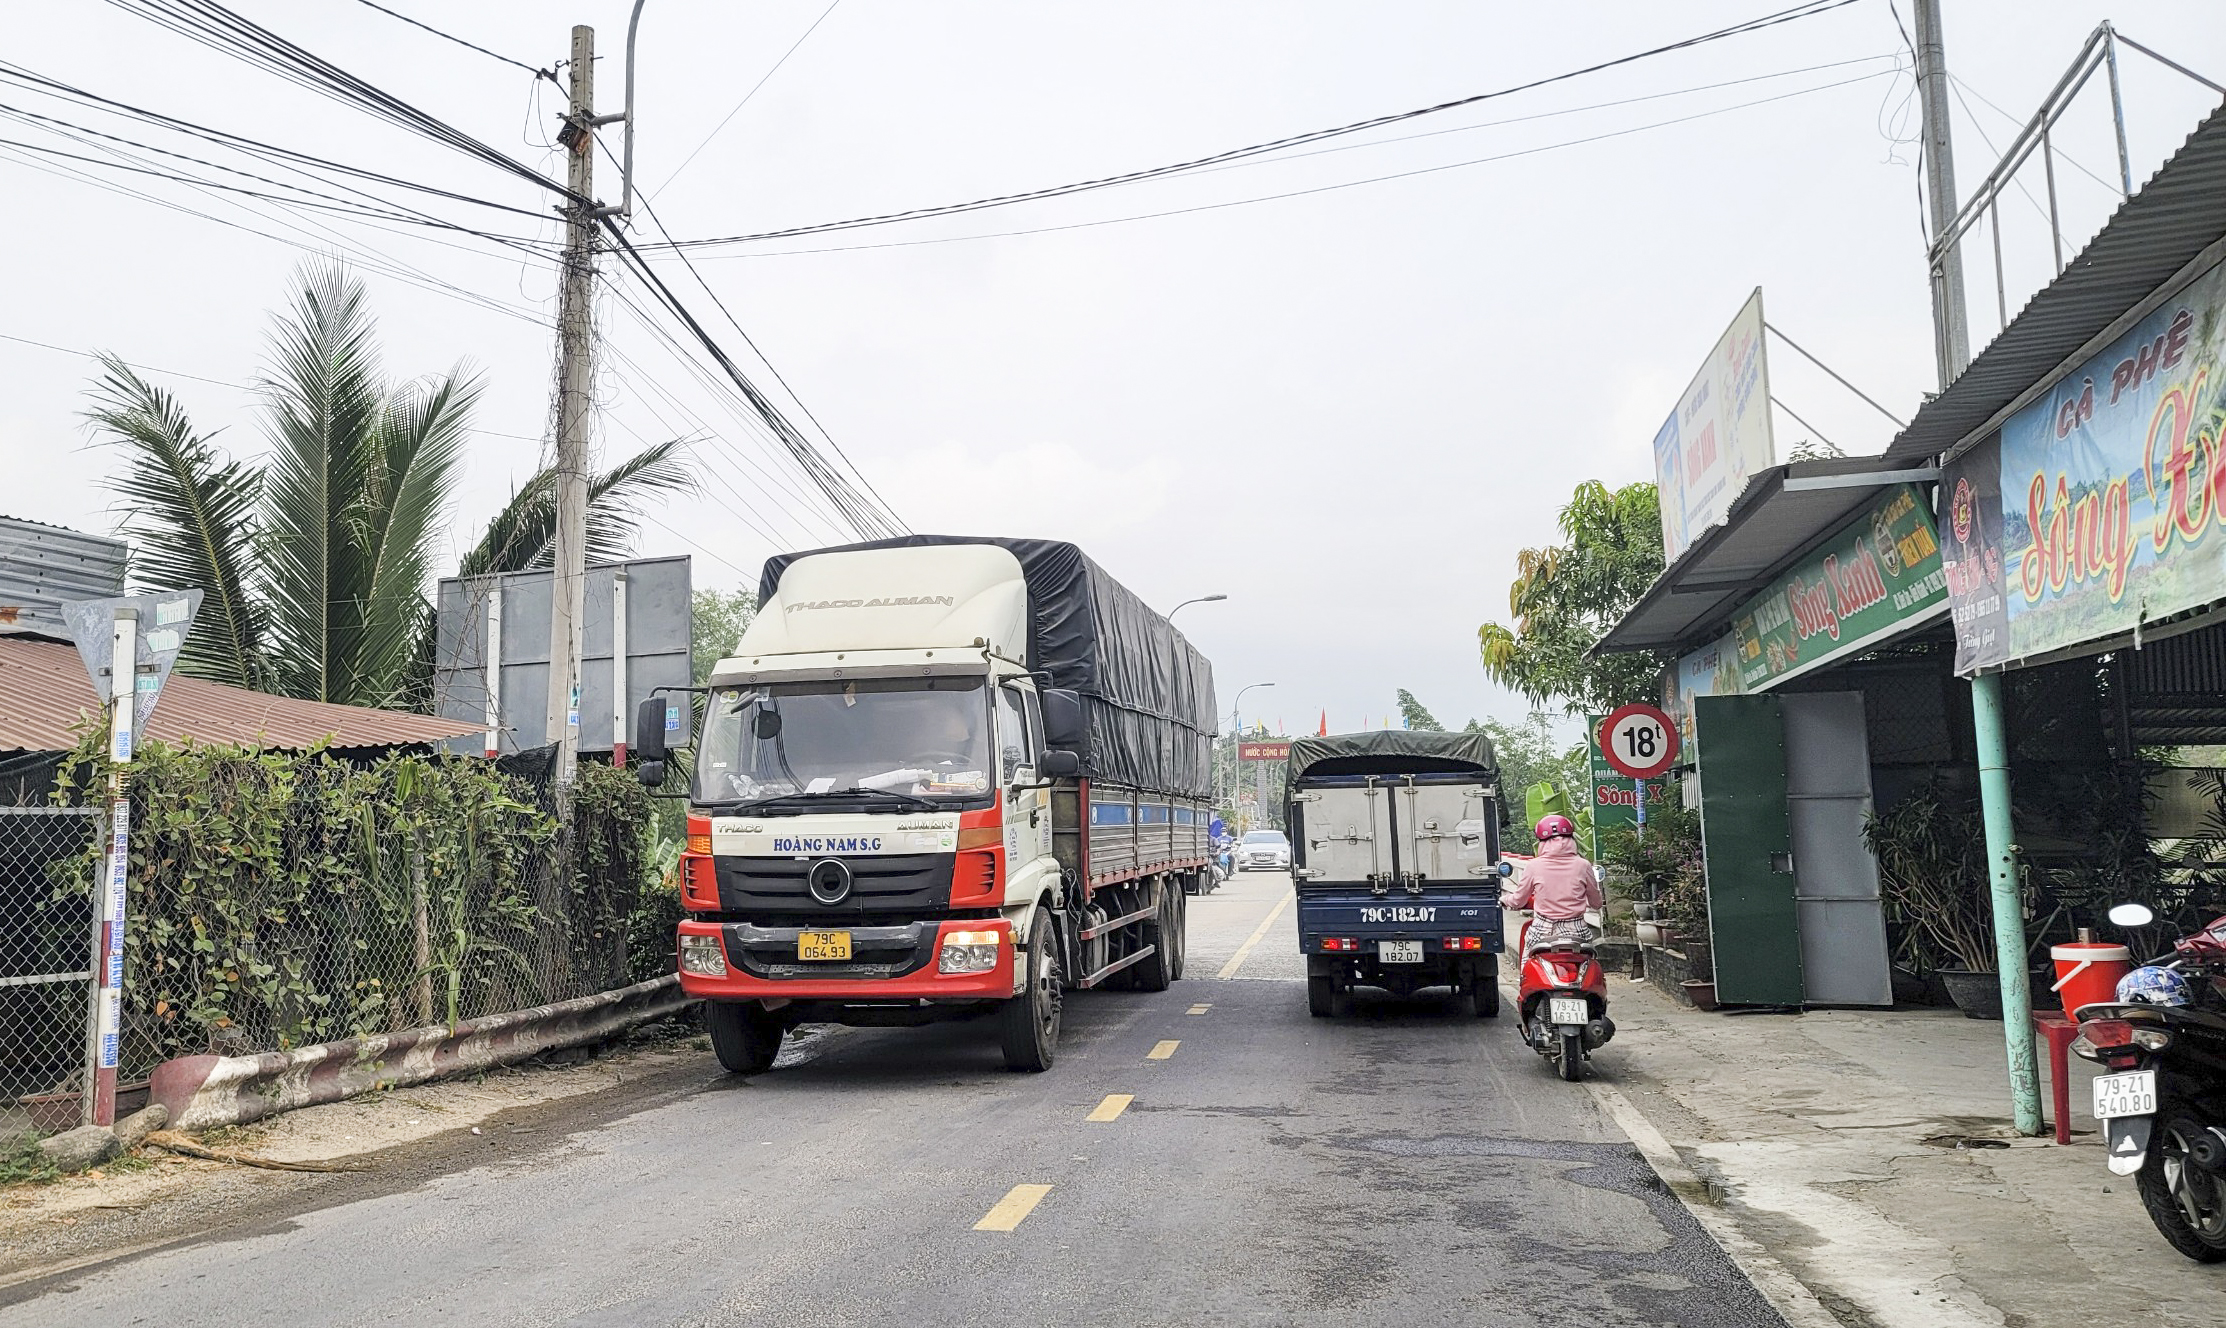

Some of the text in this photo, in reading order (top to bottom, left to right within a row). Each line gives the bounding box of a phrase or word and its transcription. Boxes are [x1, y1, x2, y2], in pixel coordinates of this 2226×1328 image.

[2055, 307, 2195, 441] CÀ PHÊ
[2021, 469, 2138, 605] Sông
[1788, 576, 1840, 641] Sông
[1824, 536, 1887, 620] Xanh
[785, 596, 954, 614] THACO AUMAN
[716, 819, 954, 834] THACO AUMAN
[773, 834, 823, 852] HOÀNG
[826, 838, 858, 852] NAM
[1360, 907, 1437, 923] 79C-182.07
[813, 933, 836, 946] 79C
[1391, 941, 1411, 951] 79C
[804, 946, 846, 958] 064.93
[1385, 952, 1419, 962] 182.07
[1556, 1000, 1581, 1011] 79-Z1
[1554, 1012, 1586, 1023] 163.14
[2103, 1075, 2144, 1097] 79-Z1
[2098, 1093, 2152, 1115] 540.80
